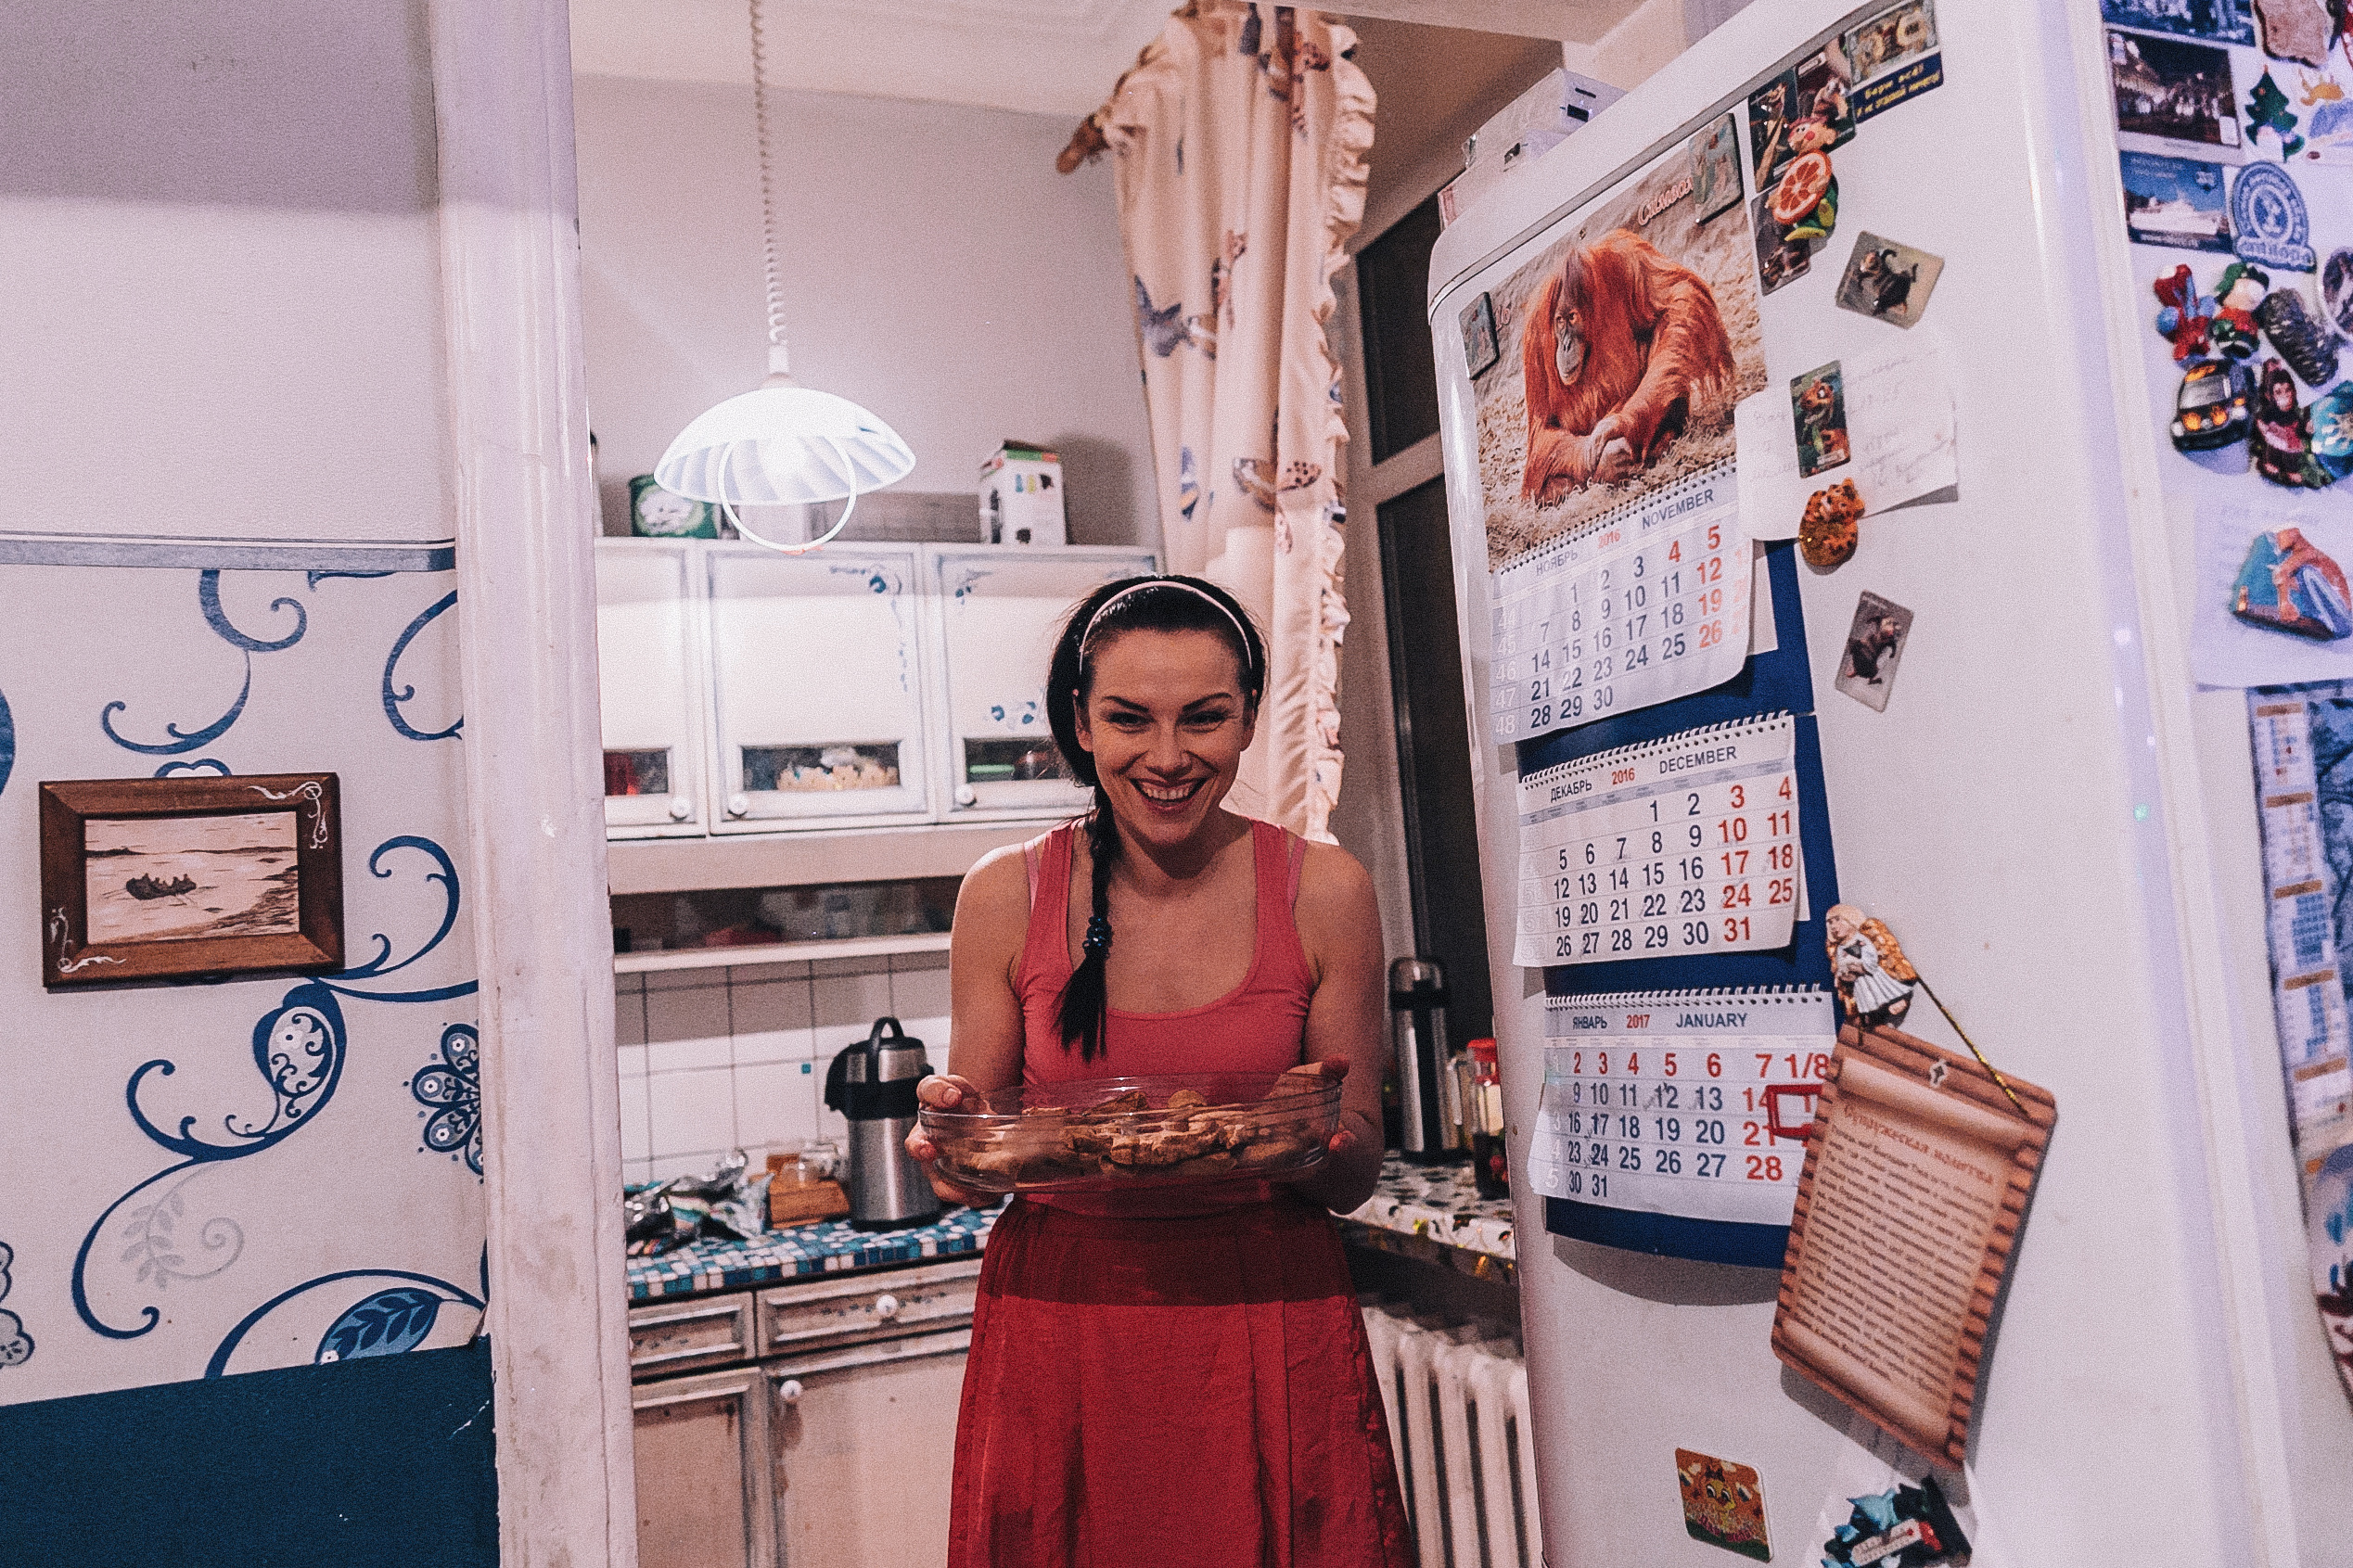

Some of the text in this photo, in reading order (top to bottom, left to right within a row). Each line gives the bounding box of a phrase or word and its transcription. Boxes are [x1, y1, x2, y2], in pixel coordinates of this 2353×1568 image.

[1643, 490, 1714, 529] NOVEMBER
[1598, 530, 1620, 549] 2016
[1536, 550, 1578, 576] НОЯБРЬ
[1571, 583, 1578, 604] 1
[1601, 569, 1610, 590] 2
[1634, 556, 1643, 577] 3
[1669, 542, 1681, 562] 4
[1707, 525, 1720, 549] 5
[1541, 622, 1550, 643] 7
[1572, 611, 1580, 631] 8
[1602, 598, 1611, 619] 9
[1625, 585, 1646, 610] 10
[1662, 572, 1680, 597] 11
[1697, 557, 1722, 585] 12
[1496, 660, 1516, 682] 46
[1532, 653, 1551, 672] 14
[1563, 640, 1581, 662] 15
[1593, 628, 1611, 651] 16
[1626, 615, 1646, 641] 17
[1662, 603, 1683, 628] 18
[1699, 589, 1722, 616] 19
[1495, 687, 1516, 708] 47
[1532, 681, 1550, 701] 21
[1563, 668, 1582, 691] 22
[1593, 657, 1612, 682] 23
[1626, 645, 1648, 670] 24
[1662, 633, 1685, 660] 25
[1699, 620, 1722, 648] 26
[1495, 685, 1612, 735] 48 28 29 30
[1612, 768, 1635, 784] 2016
[1659, 746, 1736, 773] DECEMBER
[1551, 780, 1592, 802] ДЕКАБРЬ
[1650, 800, 1657, 822] 1
[1688, 793, 1700, 815] 2
[1731, 785, 1745, 808] 3
[1779, 777, 1791, 799] 4
[1560, 849, 1567, 870] 5
[1586, 843, 1594, 864] 6
[1617, 837, 1627, 860] 7
[1652, 832, 1662, 852] 8
[1690, 824, 1701, 848] 9
[1719, 817, 1746, 843] 10
[1768, 810, 1790, 836] 11
[1554, 878, 1569, 899] 12
[1579, 873, 1596, 894] 13
[1610, 868, 1629, 890] 14
[1643, 862, 1664, 886] 15
[1680, 857, 1703, 880] 16
[1721, 850, 1749, 875] 17
[1769, 844, 1793, 870] 18
[1556, 907, 1570, 927] 19
[1581, 902, 1598, 924] 20
[1611, 898, 1629, 920] 21
[1643, 894, 1667, 917] 22
[1681, 889, 1705, 912] 23
[1723, 884, 1751, 909] 24
[1769, 879, 1792, 904] 25
[1557, 936, 1571, 957] 26
[1583, 932, 1599, 954] 27
[1612, 929, 1631, 951] 28
[1645, 925, 1668, 949] 29
[1683, 922, 1708, 945] 30
[1724, 917, 1750, 942] 31
[1573, 1015, 1607, 1029] ЯНВАРЬ
[1627, 1014, 1649, 1028] 2017
[1676, 1013, 1747, 1027] JANUARY
[1574, 1052, 1580, 1074] 2
[1599, 1052, 1608, 1075] 3
[1628, 1052, 1639, 1075] 4
[1665, 1052, 1677, 1077] 5
[1707, 1053, 1721, 1077] 6
[1755, 1053, 1772, 1077] 7
[1784, 1053, 1829, 1078] 1/8
[1574, 1082, 1580, 1103] 9
[1591, 1083, 1608, 1105] 10
[1619, 1084, 1637, 1105] 11
[1656, 1085, 1678, 1108] 12
[1695, 1087, 1722, 1111] 13
[1569, 1113, 1580, 1133] 16
[1591, 1114, 1608, 1135] 17
[1619, 1115, 1640, 1139] 18
[1656, 1118, 1680, 1141] 19
[1696, 1120, 1724, 1144] 20
[1568, 1141, 1580, 1164] 23
[1591, 1144, 1608, 1166] 24
[1619, 1147, 1641, 1170] 25
[1656, 1150, 1681, 1174] 26
[1697, 1152, 1726, 1178] 27
[1746, 1155, 1782, 1180] 28
[1569, 1171, 1581, 1193] 30
[1592, 1175, 1607, 1197] 31
